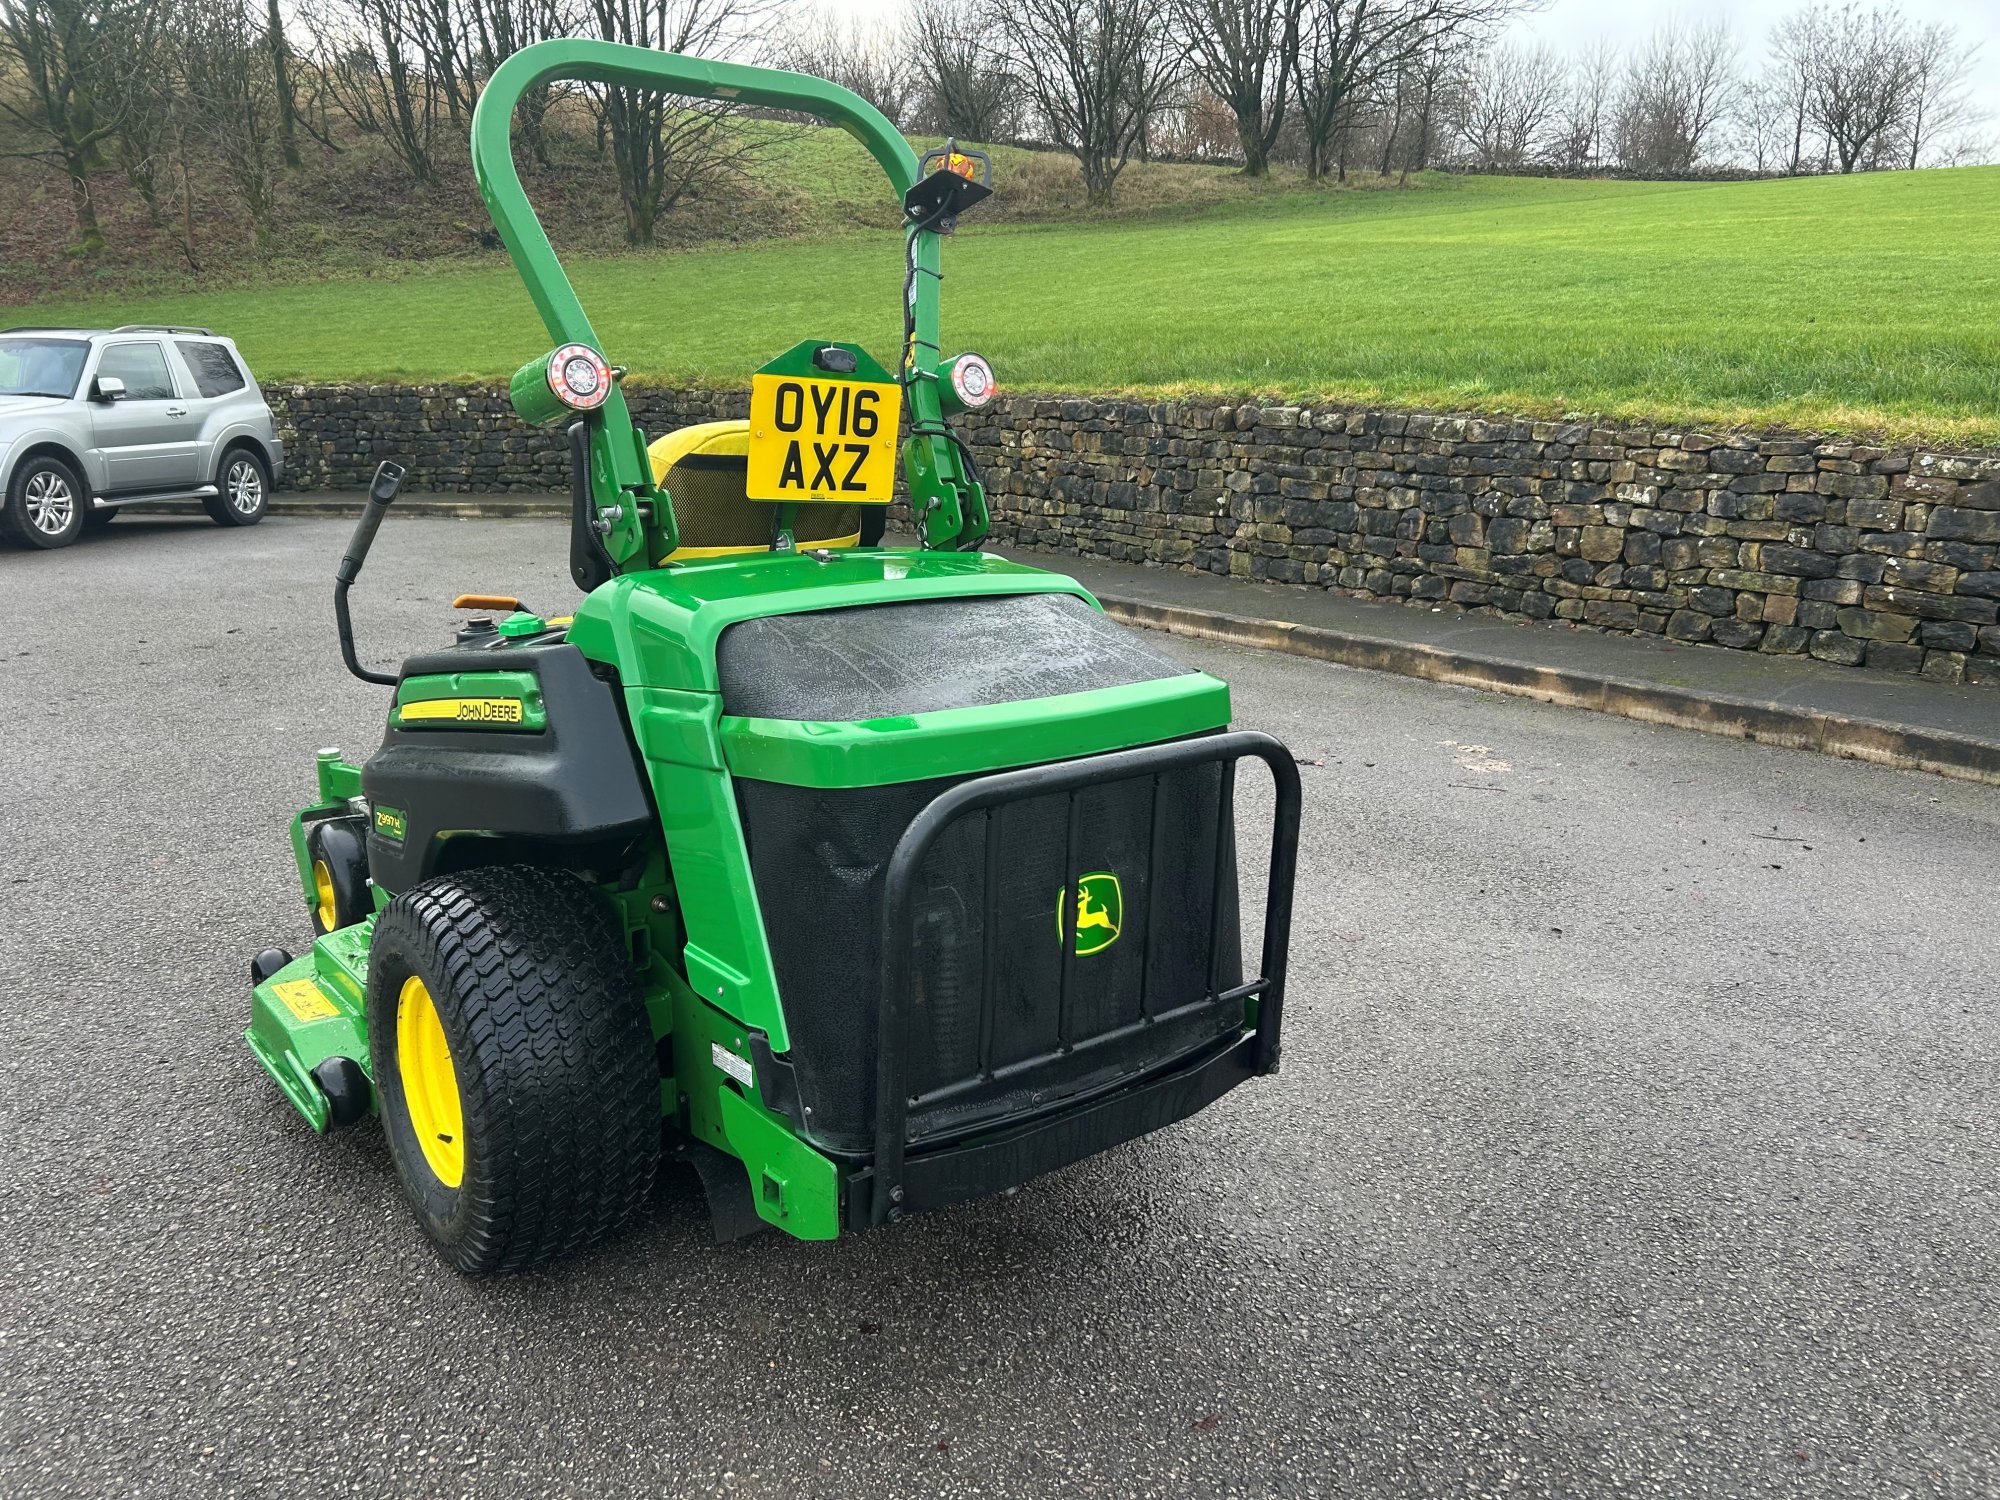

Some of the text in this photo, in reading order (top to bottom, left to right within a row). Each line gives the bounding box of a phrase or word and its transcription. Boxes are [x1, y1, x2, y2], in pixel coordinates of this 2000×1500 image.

[774, 382, 880, 438] OY16
[778, 440, 870, 491] AXZ
[456, 701, 518, 719] JOHN DEERE
